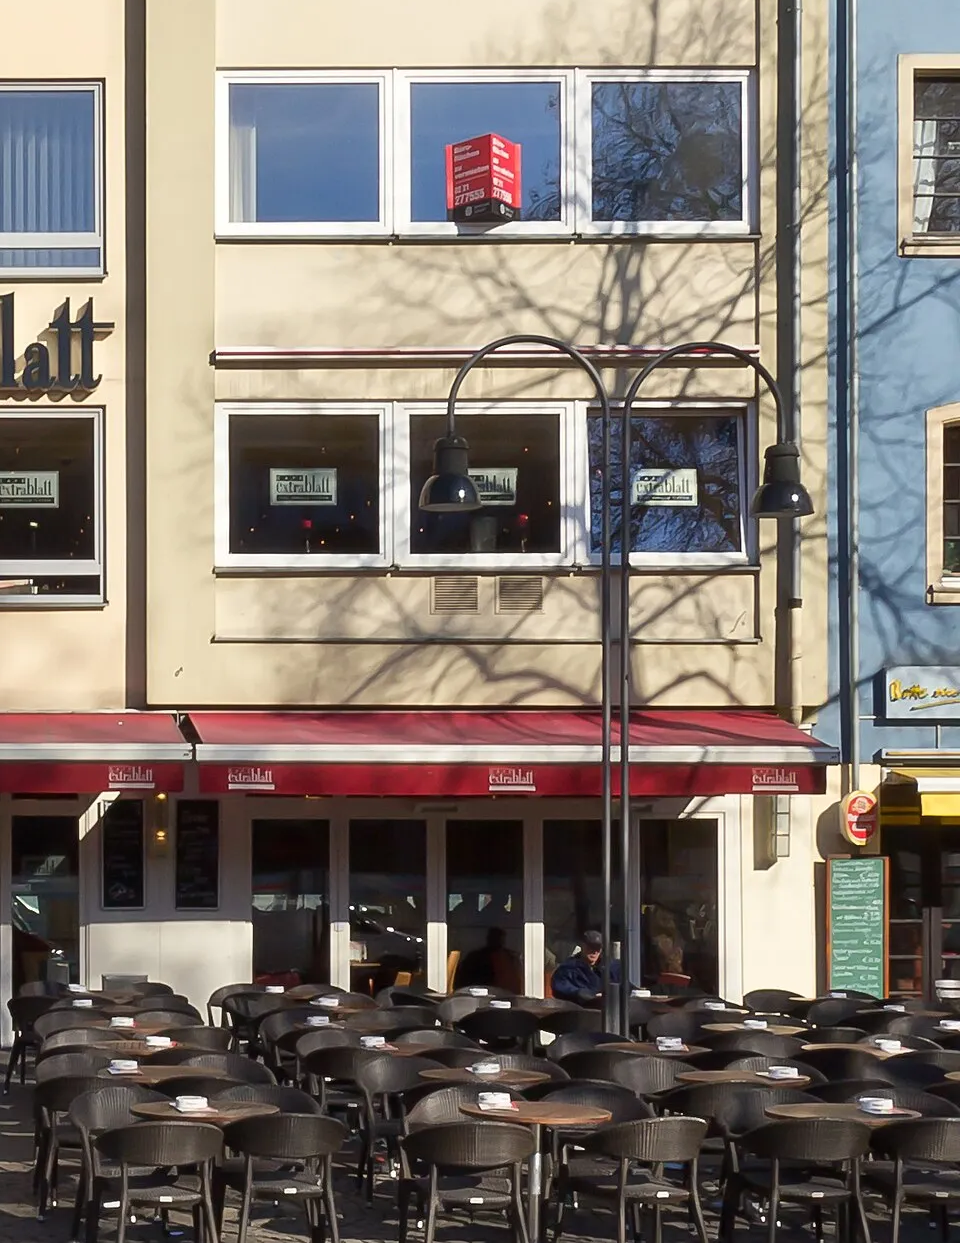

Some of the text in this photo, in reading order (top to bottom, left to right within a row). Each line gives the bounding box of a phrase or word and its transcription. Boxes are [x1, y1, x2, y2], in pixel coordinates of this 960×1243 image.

[276, 474, 330, 493] extrablatt
[108, 765, 153, 782] extrablatt
[228, 767, 272, 783] extrablatt
[489, 768, 534, 784] extrablatt
[752, 768, 797, 784] extrablatt
